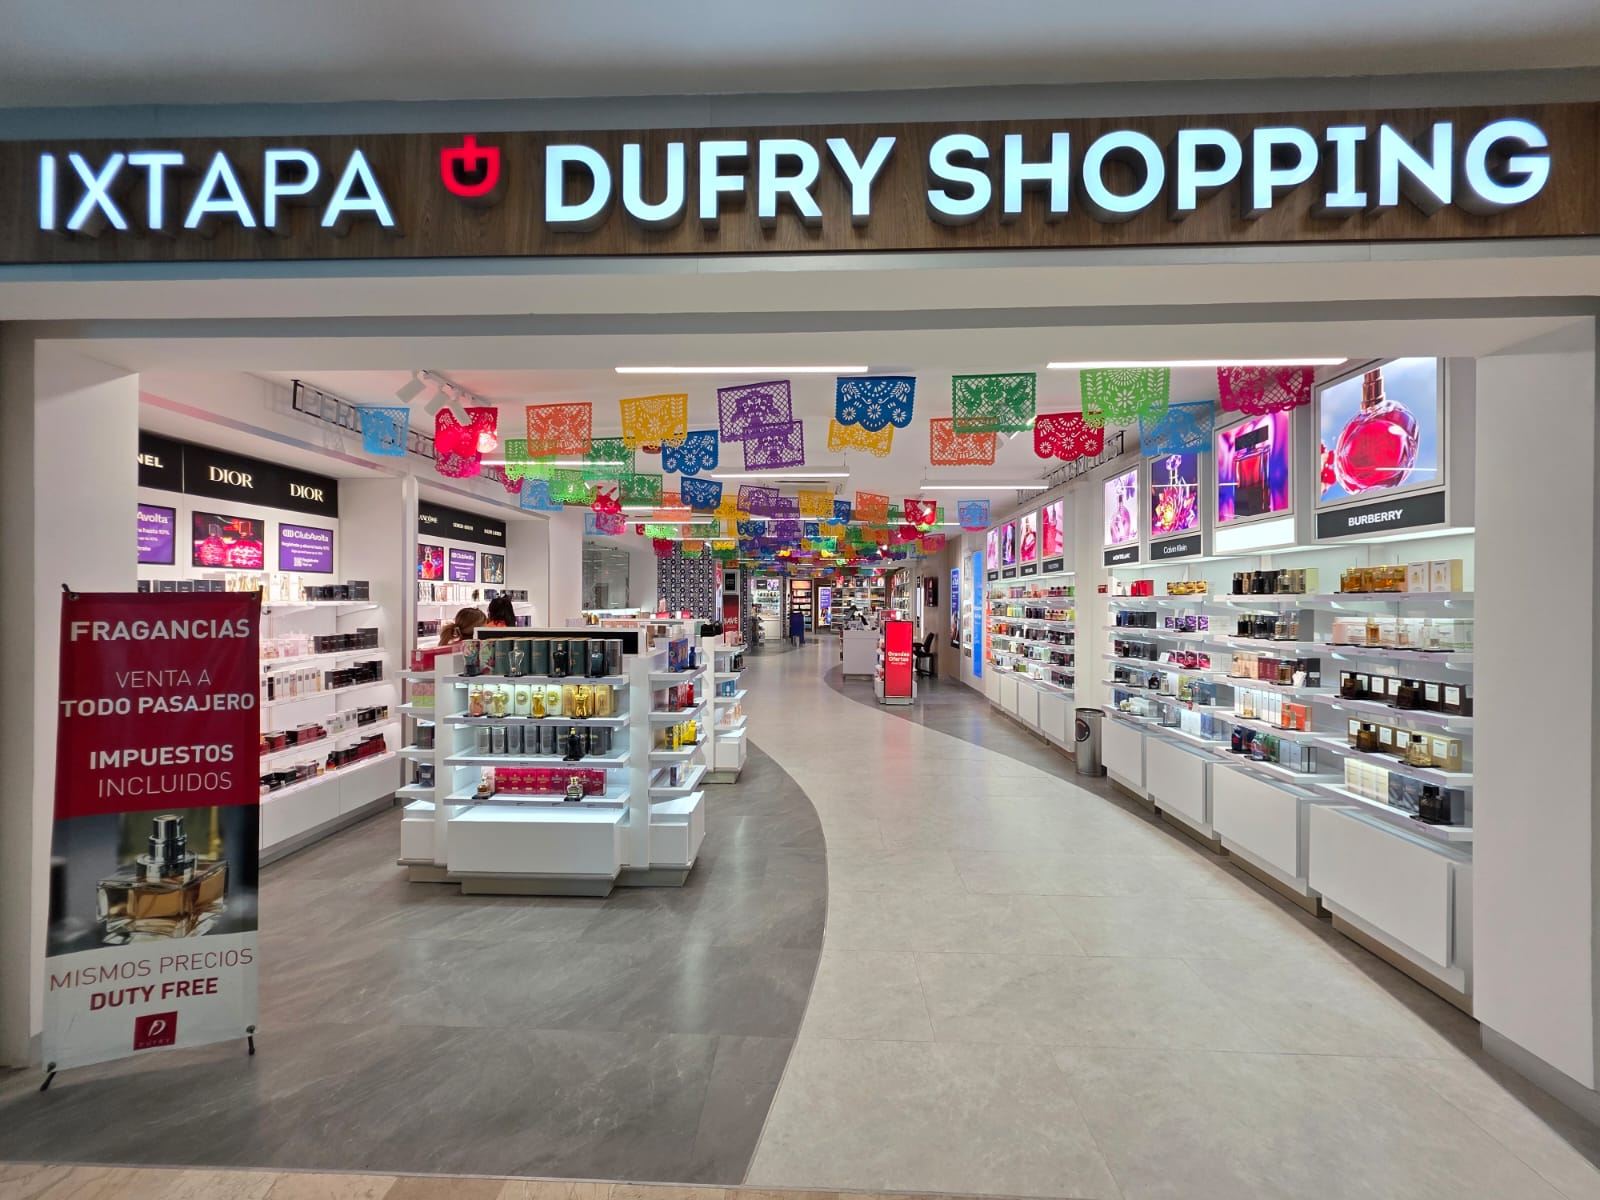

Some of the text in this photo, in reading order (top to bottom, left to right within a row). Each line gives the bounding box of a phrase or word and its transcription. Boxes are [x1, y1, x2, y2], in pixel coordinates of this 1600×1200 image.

[40, 121, 1550, 230] IXTAPA DUFRY SHOPPING
[209, 466, 254, 489] DIOR
[290, 483, 324, 503] DIOR
[1348, 509, 1403, 526] BURBERRY
[70, 618, 250, 642] FRAGANCIAS
[115, 669, 212, 689] VENTA A
[60, 693, 255, 718] TODO PASAJERO
[90, 744, 234, 770] IMPUESTOS
[98, 771, 232, 798] INCLUIDOS
[50, 948, 253, 992] MISMOS PRECIOS
[90, 977, 219, 1011] DUTY FREE
